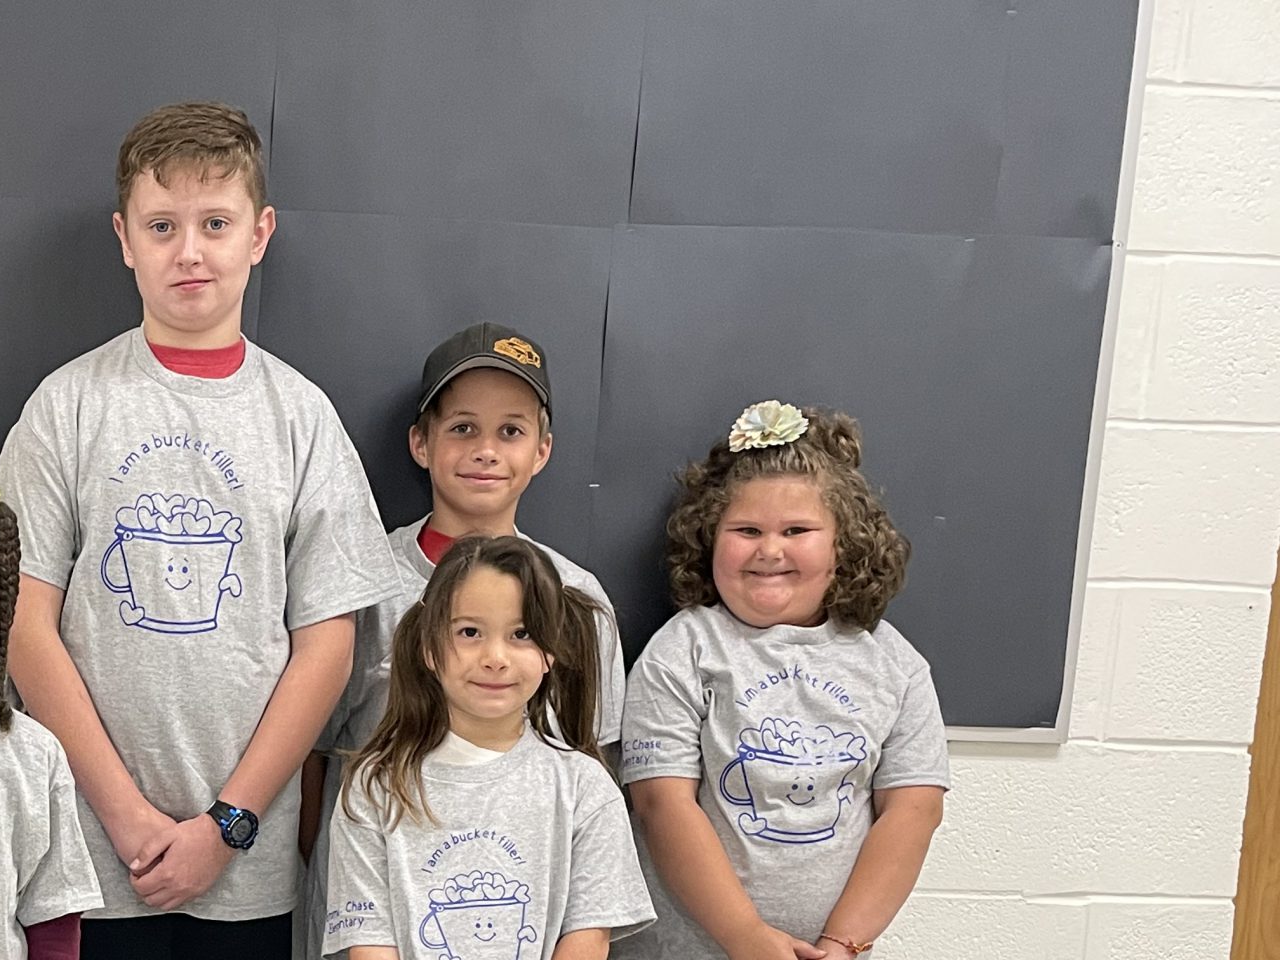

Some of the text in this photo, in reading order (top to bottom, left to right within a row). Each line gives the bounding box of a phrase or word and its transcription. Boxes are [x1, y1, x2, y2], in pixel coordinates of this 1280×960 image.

[119, 452, 140, 475] am
[141, 443, 150, 454] a
[152, 433, 210, 455] bucket
[211, 450, 244, 491] filler!
[735, 700, 748, 708] I
[744, 688, 758, 702] m
[758, 681, 768, 690] a
[766, 664, 818, 688] bukt
[632, 739, 661, 751] Chase
[427, 849, 443, 867] am
[443, 841, 451, 850] a
[450, 829, 496, 845] bucket
[498, 836, 526, 866] filler!
[346, 901, 375, 912] Chase
